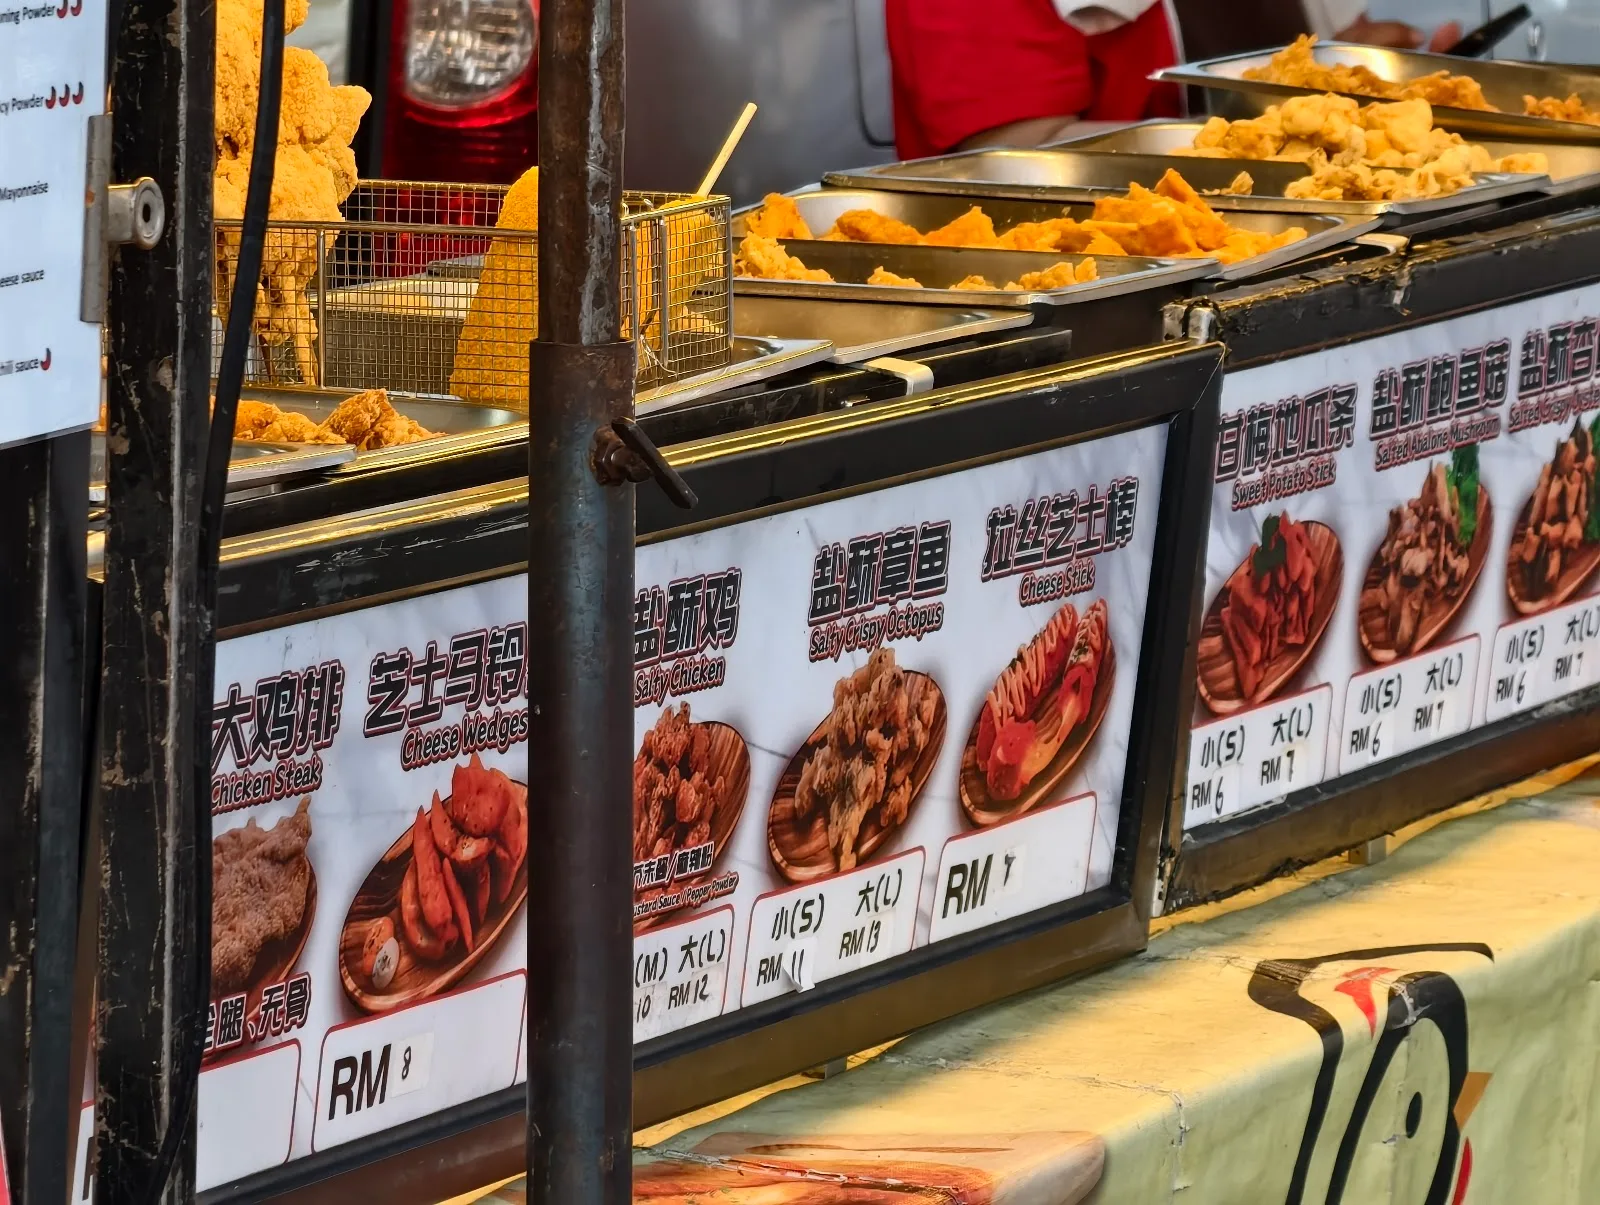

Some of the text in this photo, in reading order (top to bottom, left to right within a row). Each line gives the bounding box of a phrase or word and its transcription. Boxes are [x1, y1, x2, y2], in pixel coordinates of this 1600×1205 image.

[22, 3, 55, 20] Powder
[12, 94, 44, 112] Powder
[21, 269, 44, 284] sauce
[15, 358, 38, 373] sauce
[1517, 317, 1600, 400] 盐酥杏
[1214, 383, 1358, 484] 甘梅地瓜条
[1232, 453, 1336, 511] Sweet Potato Stick
[981, 476, 1139, 582] 拉丝芝士棒
[808, 520, 951, 627] 盐酥章鱼
[1019, 557, 1095, 607] Cheese Stick
[809, 601, 944, 662] Salty Crispy Octopus
[1505, 624, 1545, 664] 小(S)
[364, 622, 528, 737] 芝士马铃
[634, 654, 726, 706] Salty Chicken
[1360, 652, 1463, 715] 小(S) 大(L)
[1496, 674, 1514, 703] RM
[1517, 670, 1527, 704] 6
[1554, 653, 1573, 682] RM
[212, 661, 345, 773] 大鸡排
[402, 706, 528, 770] Cheese Wedges
[1201, 702, 1313, 769] 小(S) 大(L)
[1349, 725, 1370, 755] RM
[1372, 721, 1382, 757] 6
[1413, 703, 1434, 733] RM
[274, 754, 322, 801] Steak
[1191, 779, 1212, 810] RM
[1215, 776, 1224, 815] 6
[1260, 756, 1281, 786] RM
[659, 892, 681, 909] Sauce
[686, 885, 712, 905] Pepper
[712, 875, 736, 896] Powder
[771, 868, 902, 941] 小(S) 大(L)
[942, 853, 994, 919] RM
[635, 928, 726, 988] (M) 大(L)
[756, 920, 881, 987] RM 11 RM 13
[636, 973, 709, 1023] 10 RM 12
[328, 1044, 412, 1121] RM 8
